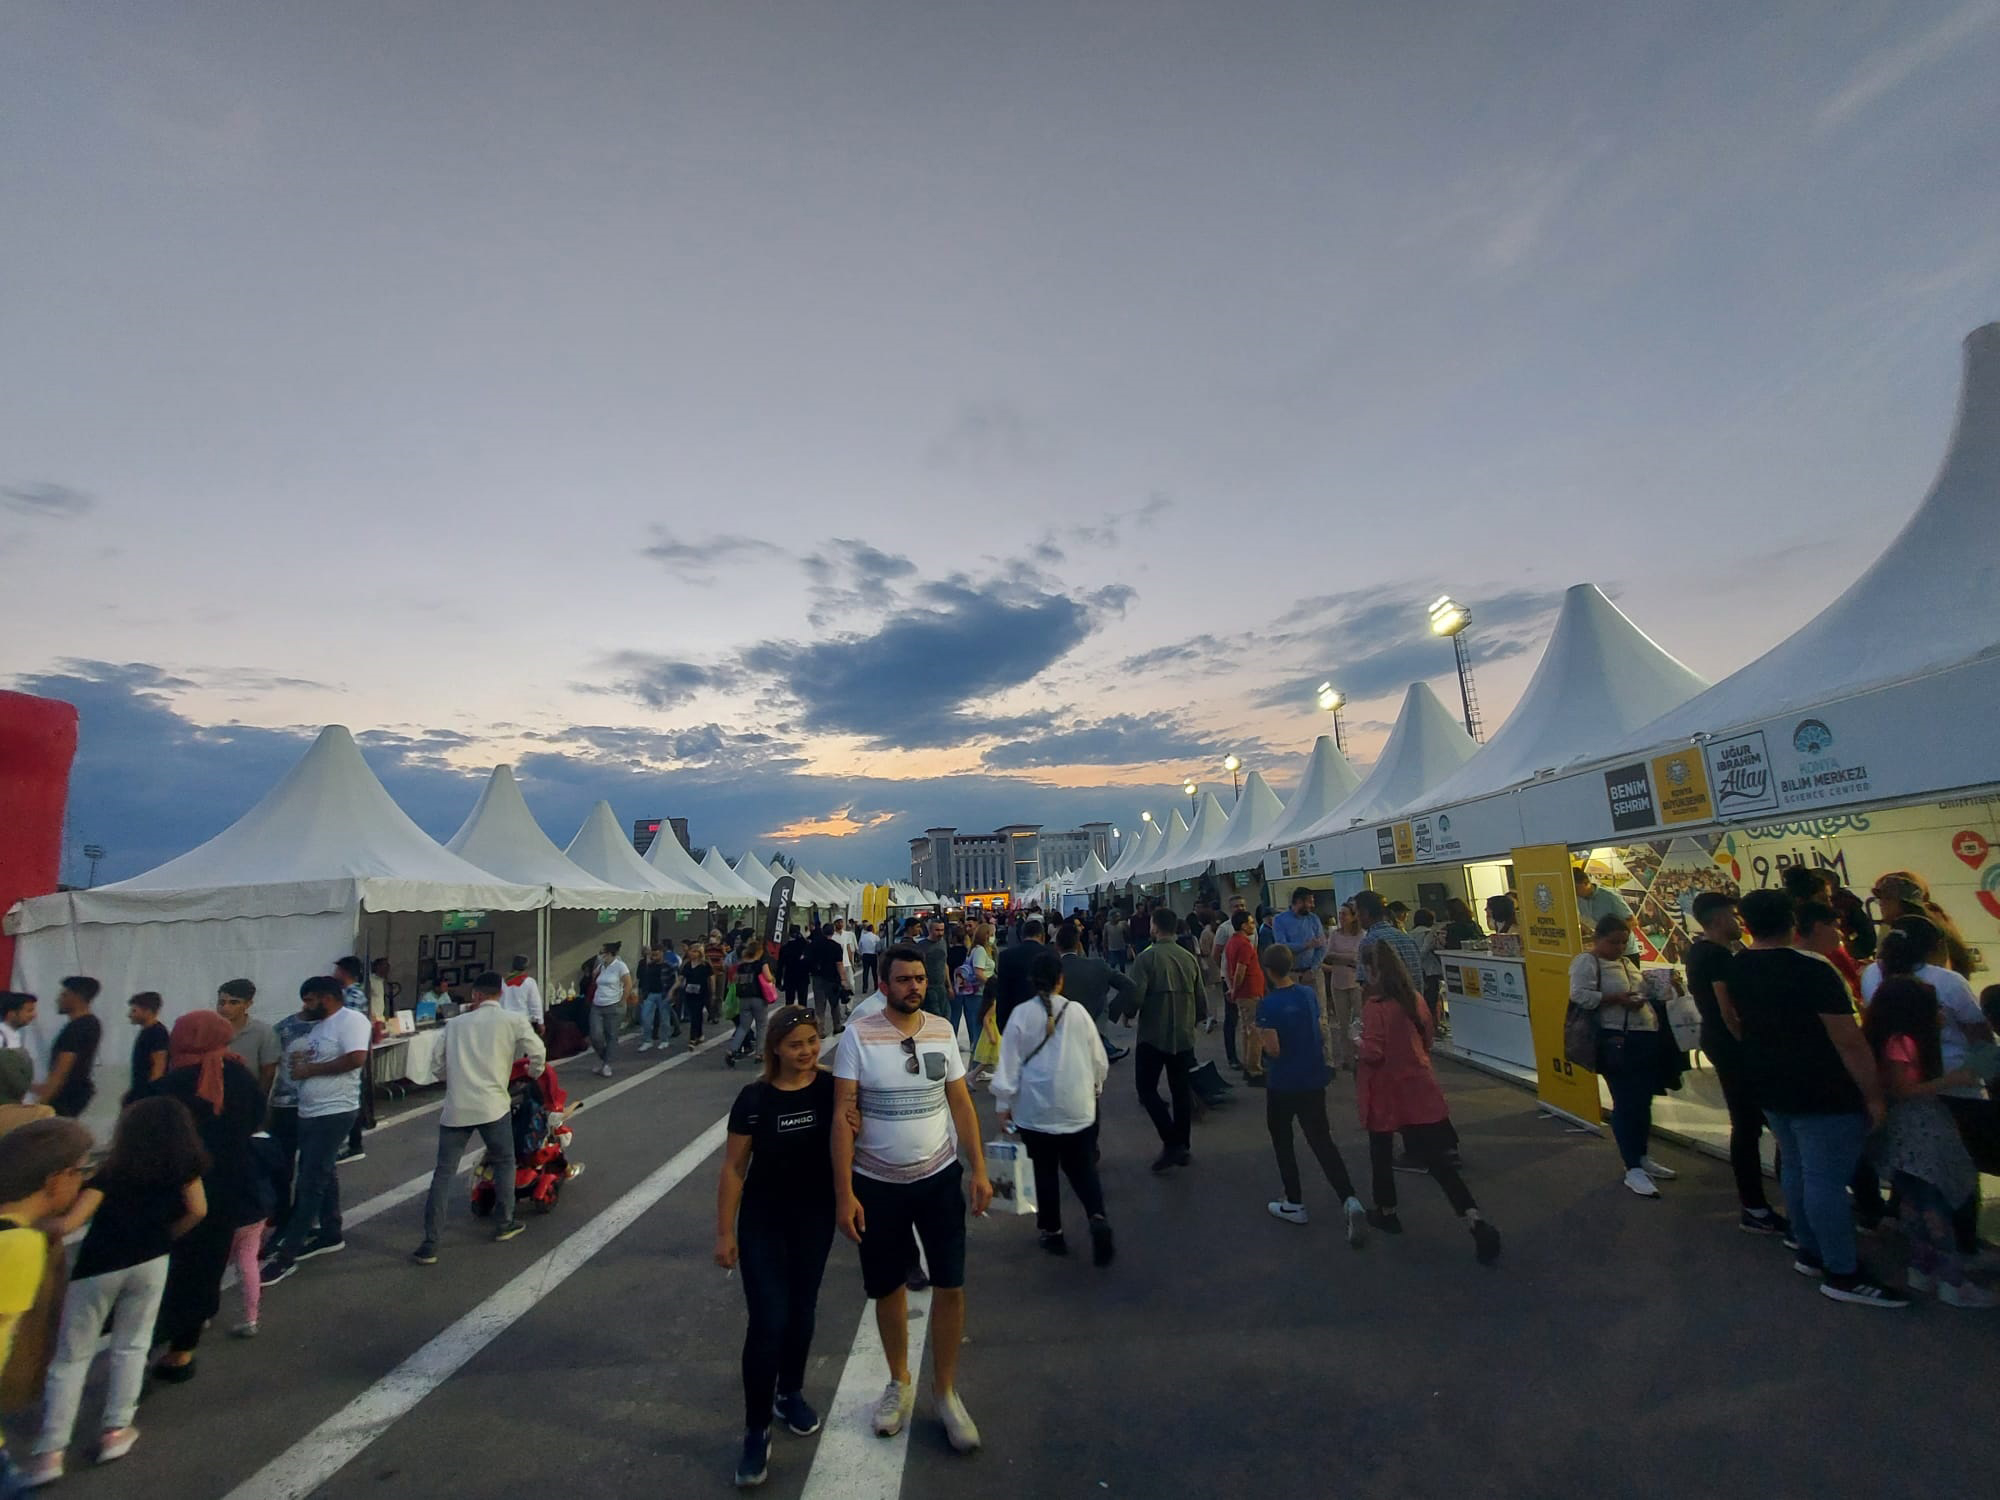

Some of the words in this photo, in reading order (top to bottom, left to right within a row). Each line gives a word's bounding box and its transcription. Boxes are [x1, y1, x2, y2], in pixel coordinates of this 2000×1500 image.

[1717, 753, 1762, 771] İBRAHİM
[1721, 745, 1752, 760] UĞUR
[1609, 779, 1648, 800] BENİM
[1719, 768, 1767, 802] Altay
[1613, 798, 1651, 817] ŞEHRİM
